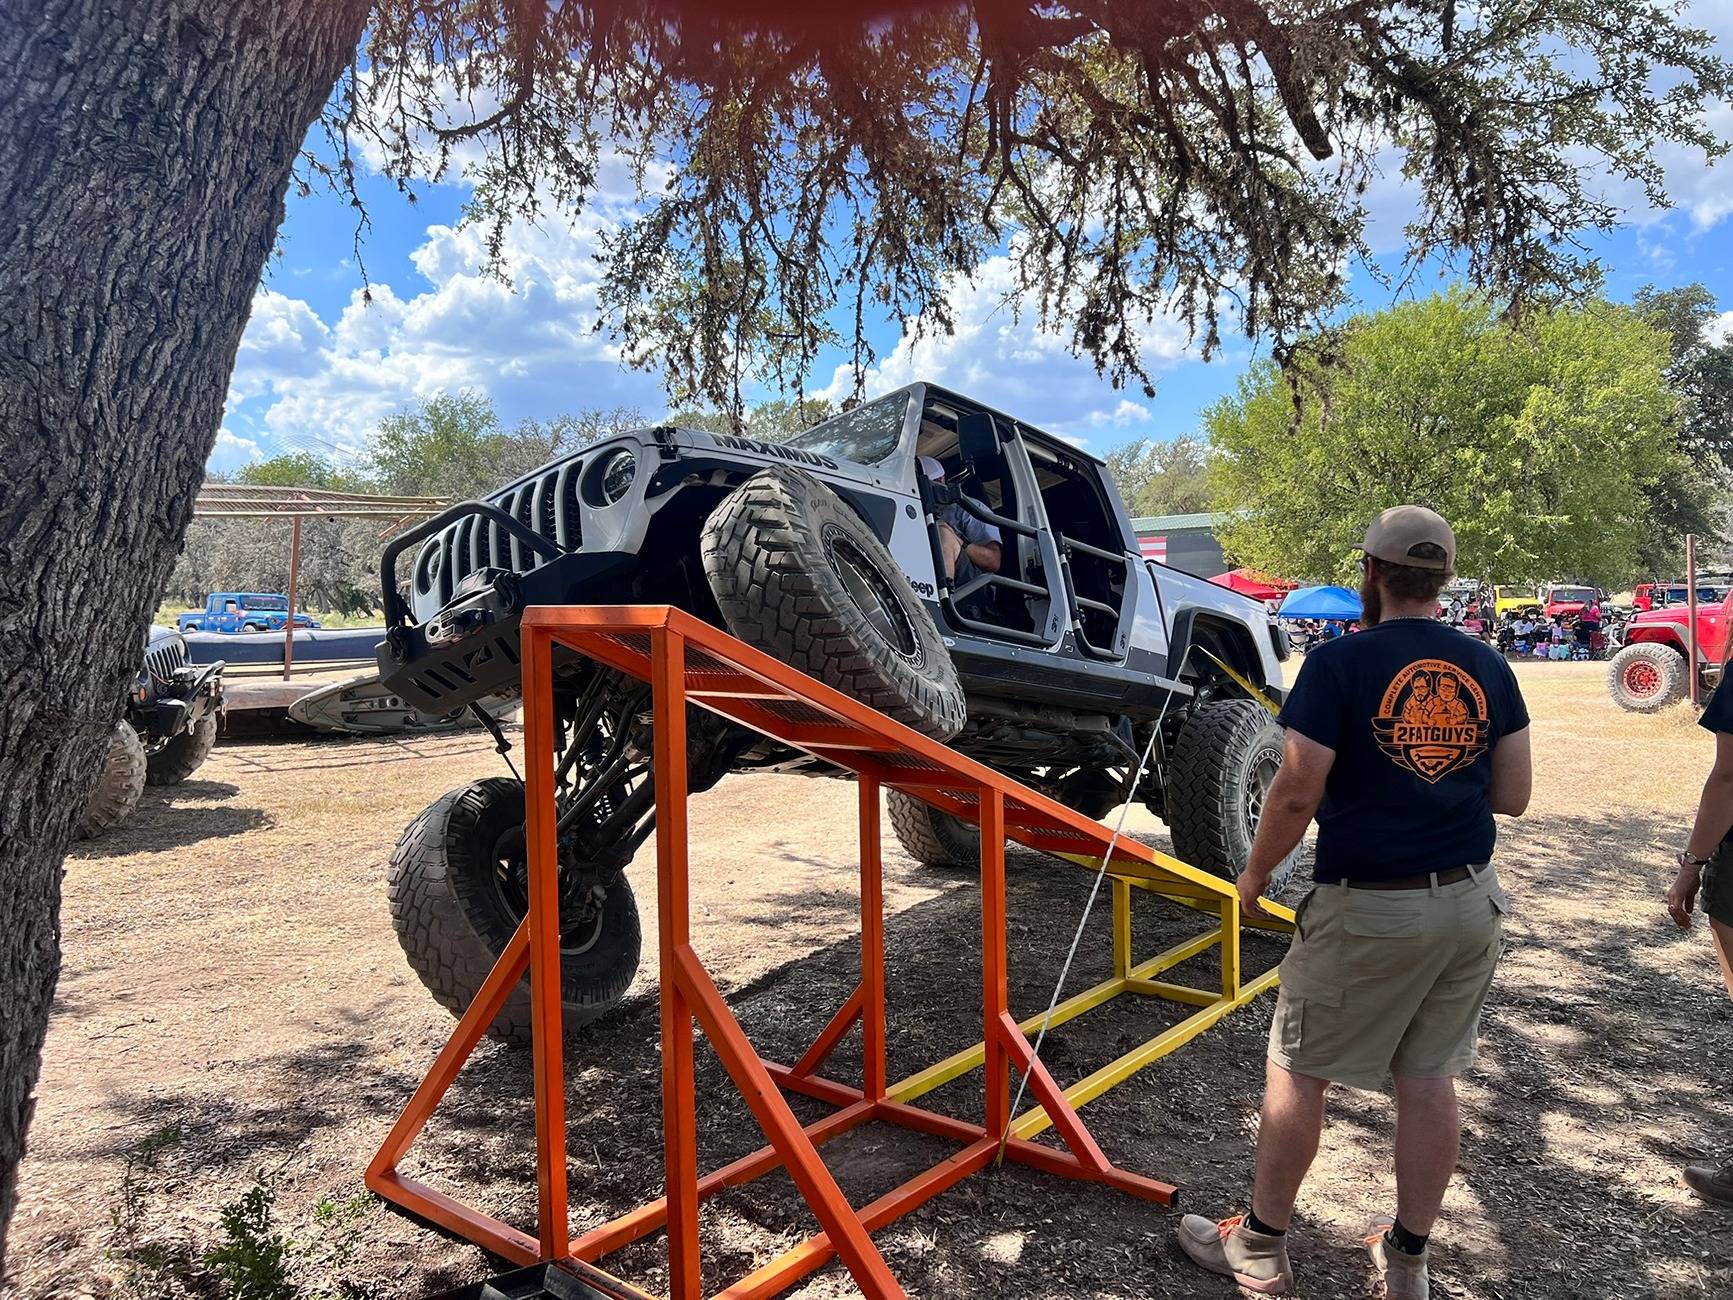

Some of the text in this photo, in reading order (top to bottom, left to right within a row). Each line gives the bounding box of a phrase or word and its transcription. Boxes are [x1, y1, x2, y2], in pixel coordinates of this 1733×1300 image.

[708, 433, 839, 471] MAXIMUS
[1383, 677, 1404, 715] COMPLETE
[1402, 662, 1441, 679] AUTOMOTIVE
[1443, 664, 1470, 683] SERVICE
[1397, 726, 1475, 743] 2FATGUYS
